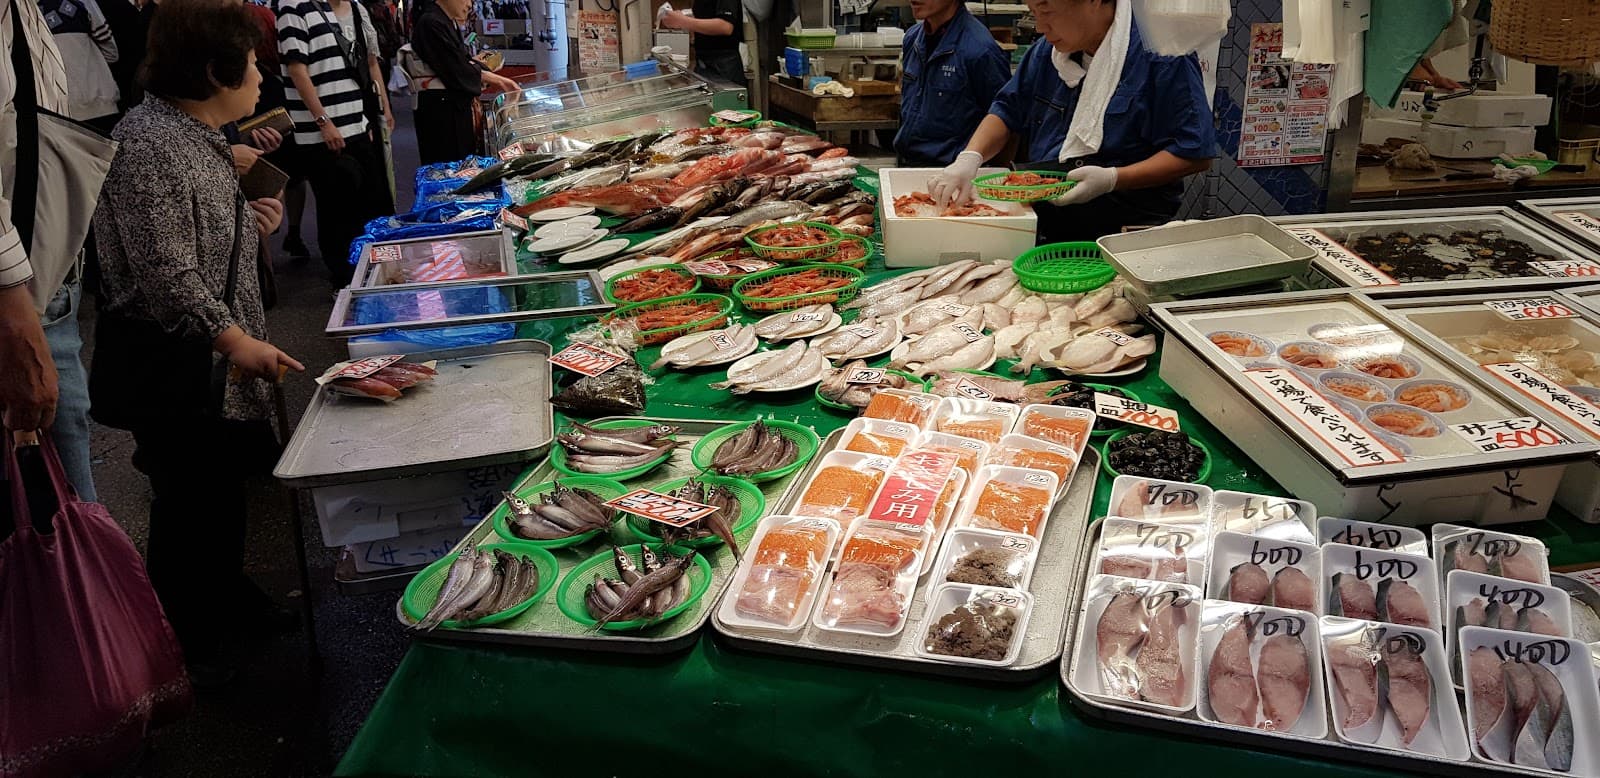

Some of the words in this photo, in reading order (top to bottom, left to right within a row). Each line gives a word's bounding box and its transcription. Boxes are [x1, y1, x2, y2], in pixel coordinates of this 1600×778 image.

[1522, 305, 1573, 318] 600
[1258, 370, 1386, 463] この場で食べられます
[1458, 419, 1543, 436] サーモン
[1147, 484, 1199, 505] 700
[1243, 497, 1302, 521] 650
[1136, 523, 1195, 548] 700
[1466, 532, 1522, 557] 700
[1251, 540, 1303, 565] 600
[1355, 550, 1418, 580] 600
[1479, 583, 1545, 609] 400
[1242, 610, 1306, 643] 700
